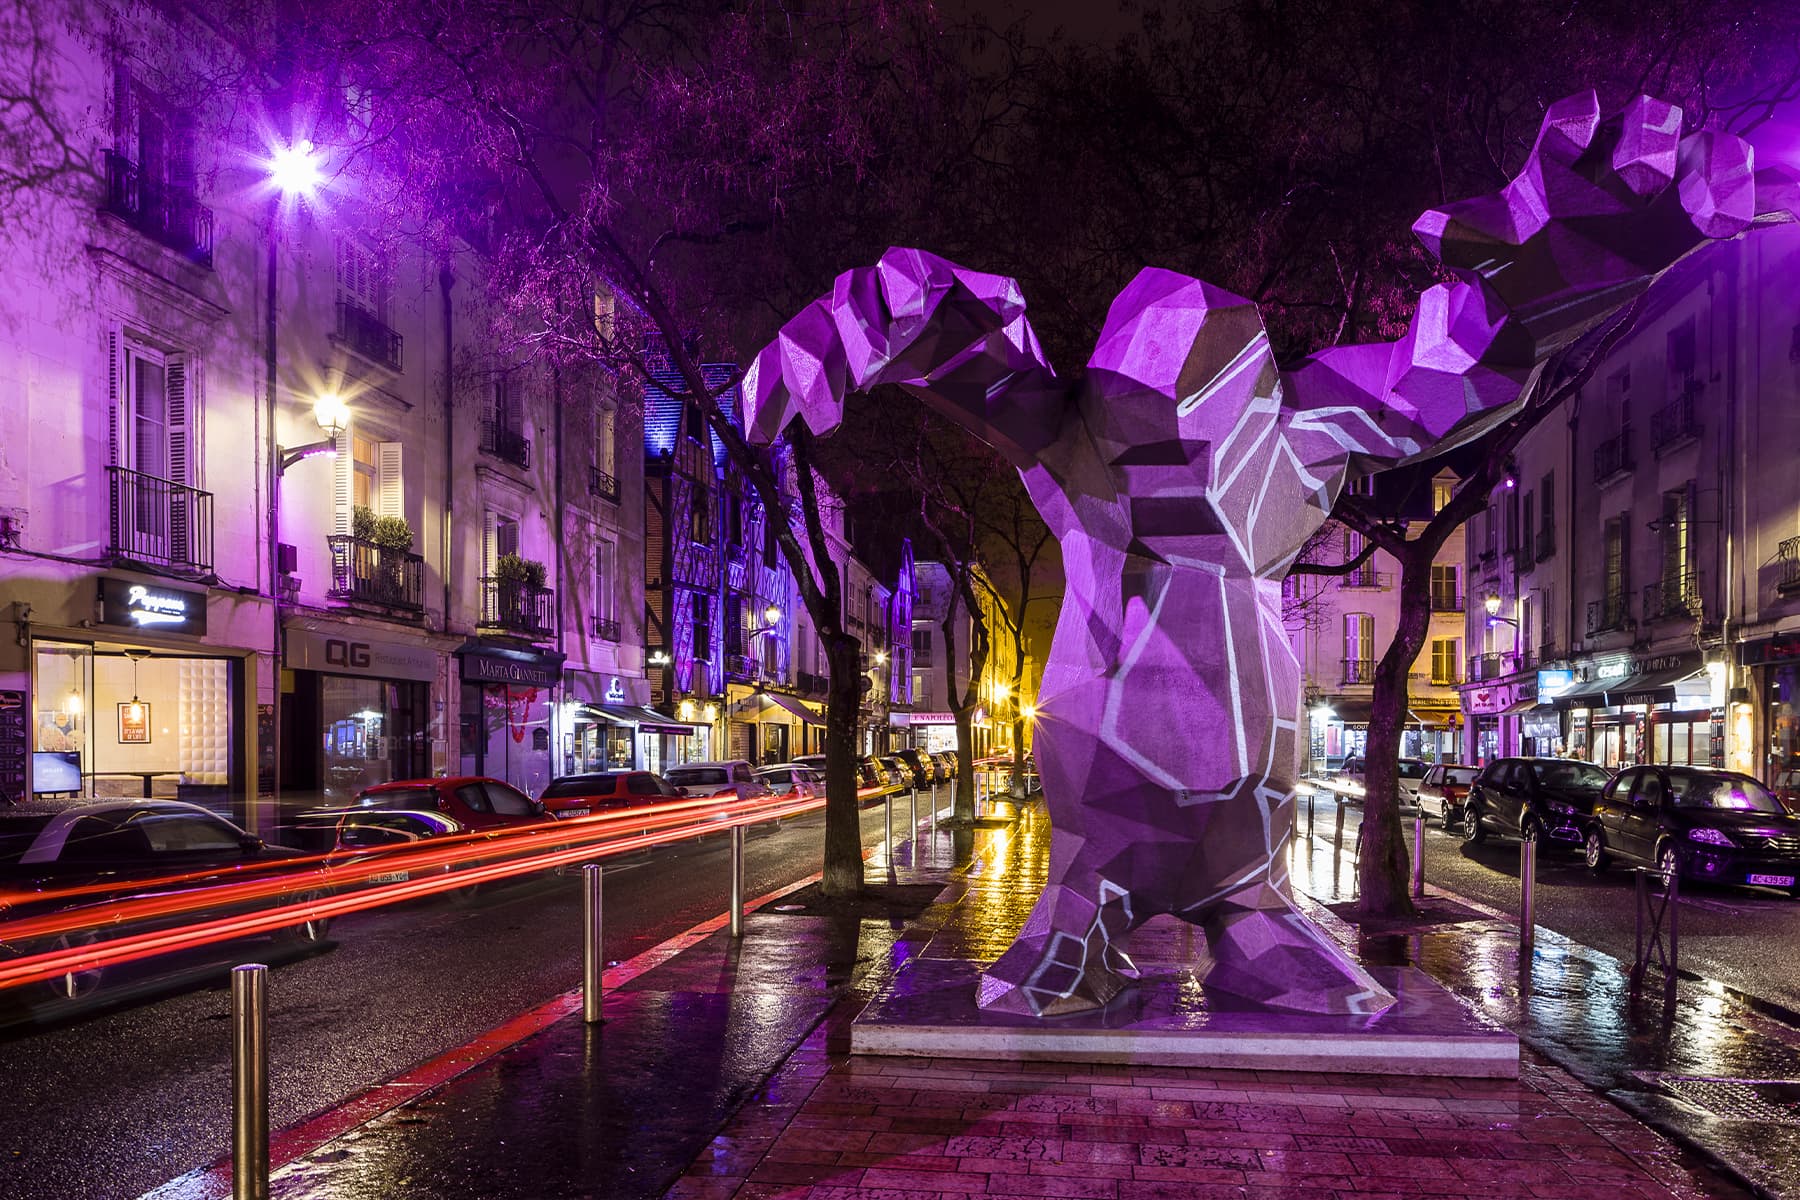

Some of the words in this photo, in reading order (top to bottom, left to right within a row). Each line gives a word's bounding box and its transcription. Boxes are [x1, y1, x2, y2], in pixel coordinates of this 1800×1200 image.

[325, 638, 371, 668] QG
[480, 659, 509, 679] MARTA
[509, 663, 547, 682] GIANNETTI
